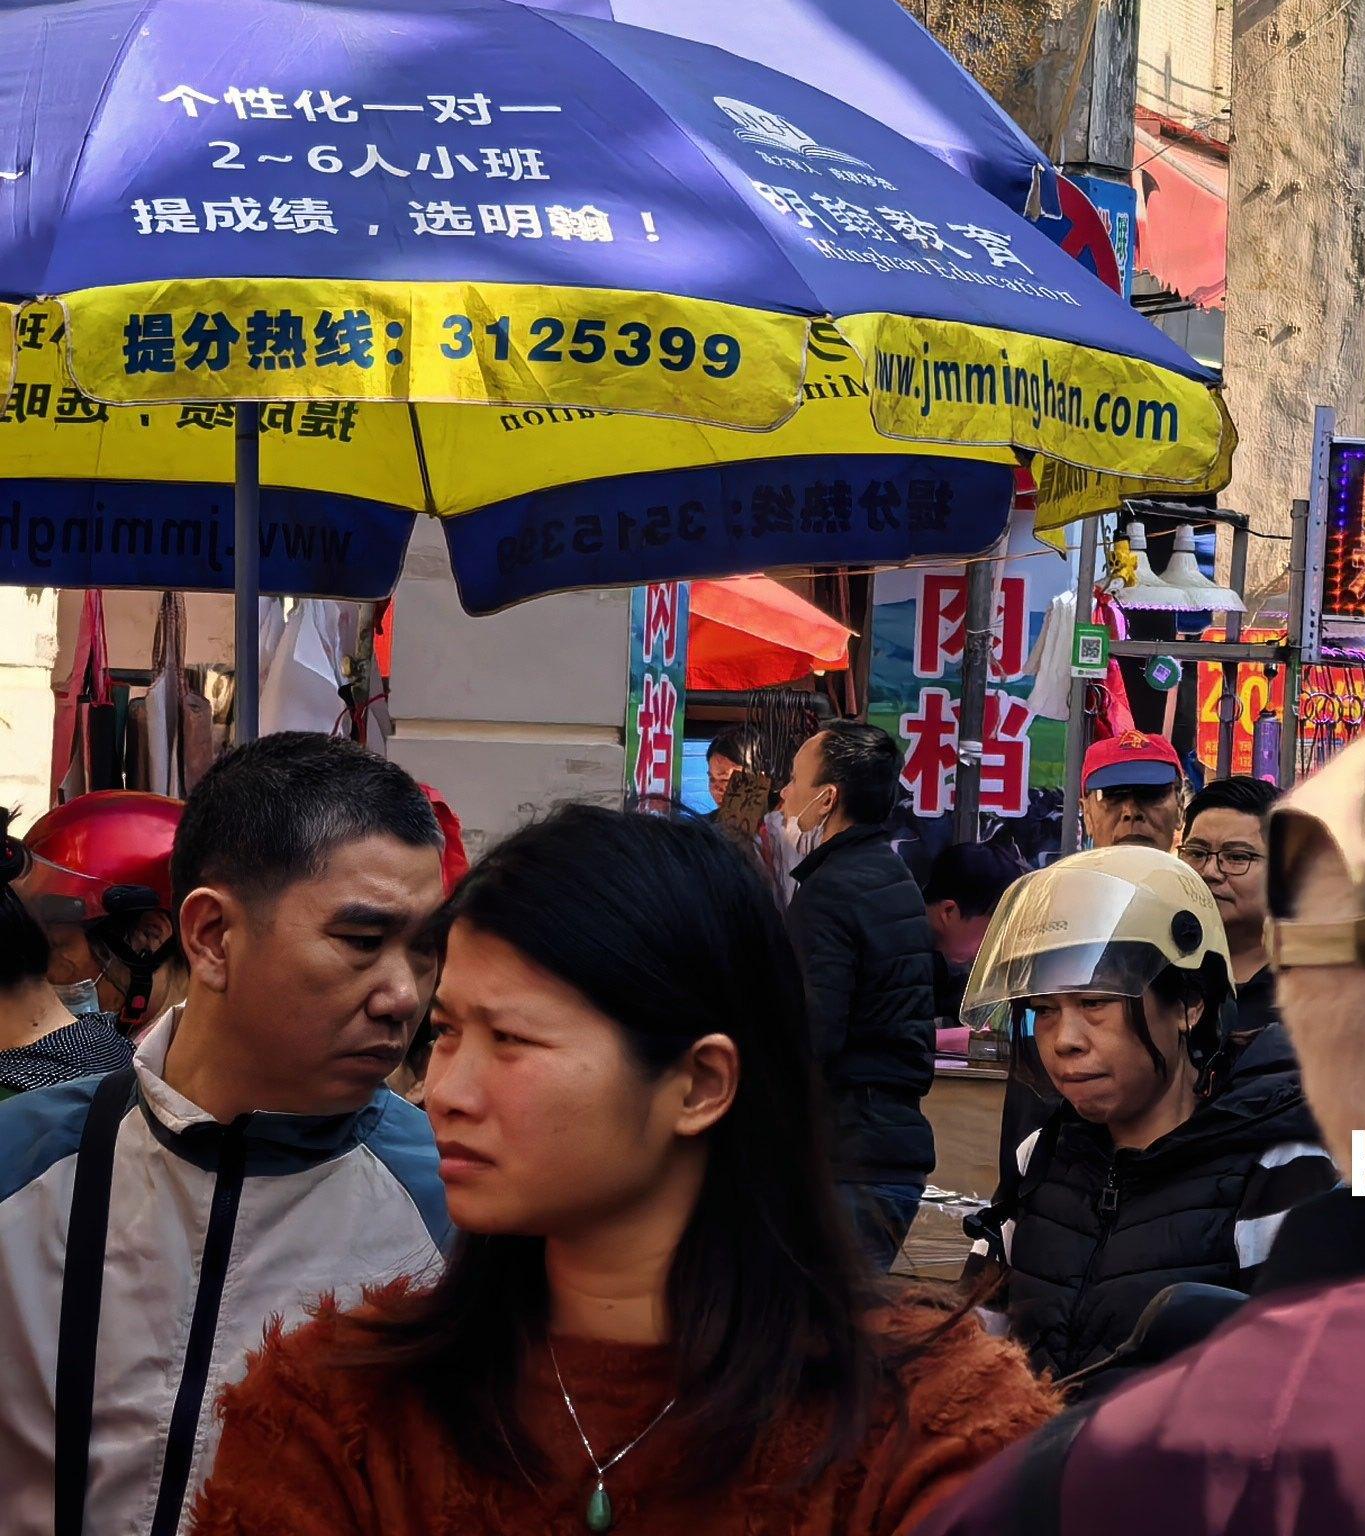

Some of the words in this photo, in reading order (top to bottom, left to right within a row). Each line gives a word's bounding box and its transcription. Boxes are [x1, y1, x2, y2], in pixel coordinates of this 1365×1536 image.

[158, 84, 562, 126] 个性化一对一
[208, 141, 550, 181] 2~6人小班
[131, 196, 660, 243] 提成绩，选明翰！
[752, 179, 1034, 275] 明翰教育
[805, 237, 931, 274] Minghan
[930, 258, 1082, 307] Education
[899, 572, 1030, 816] 肉档
